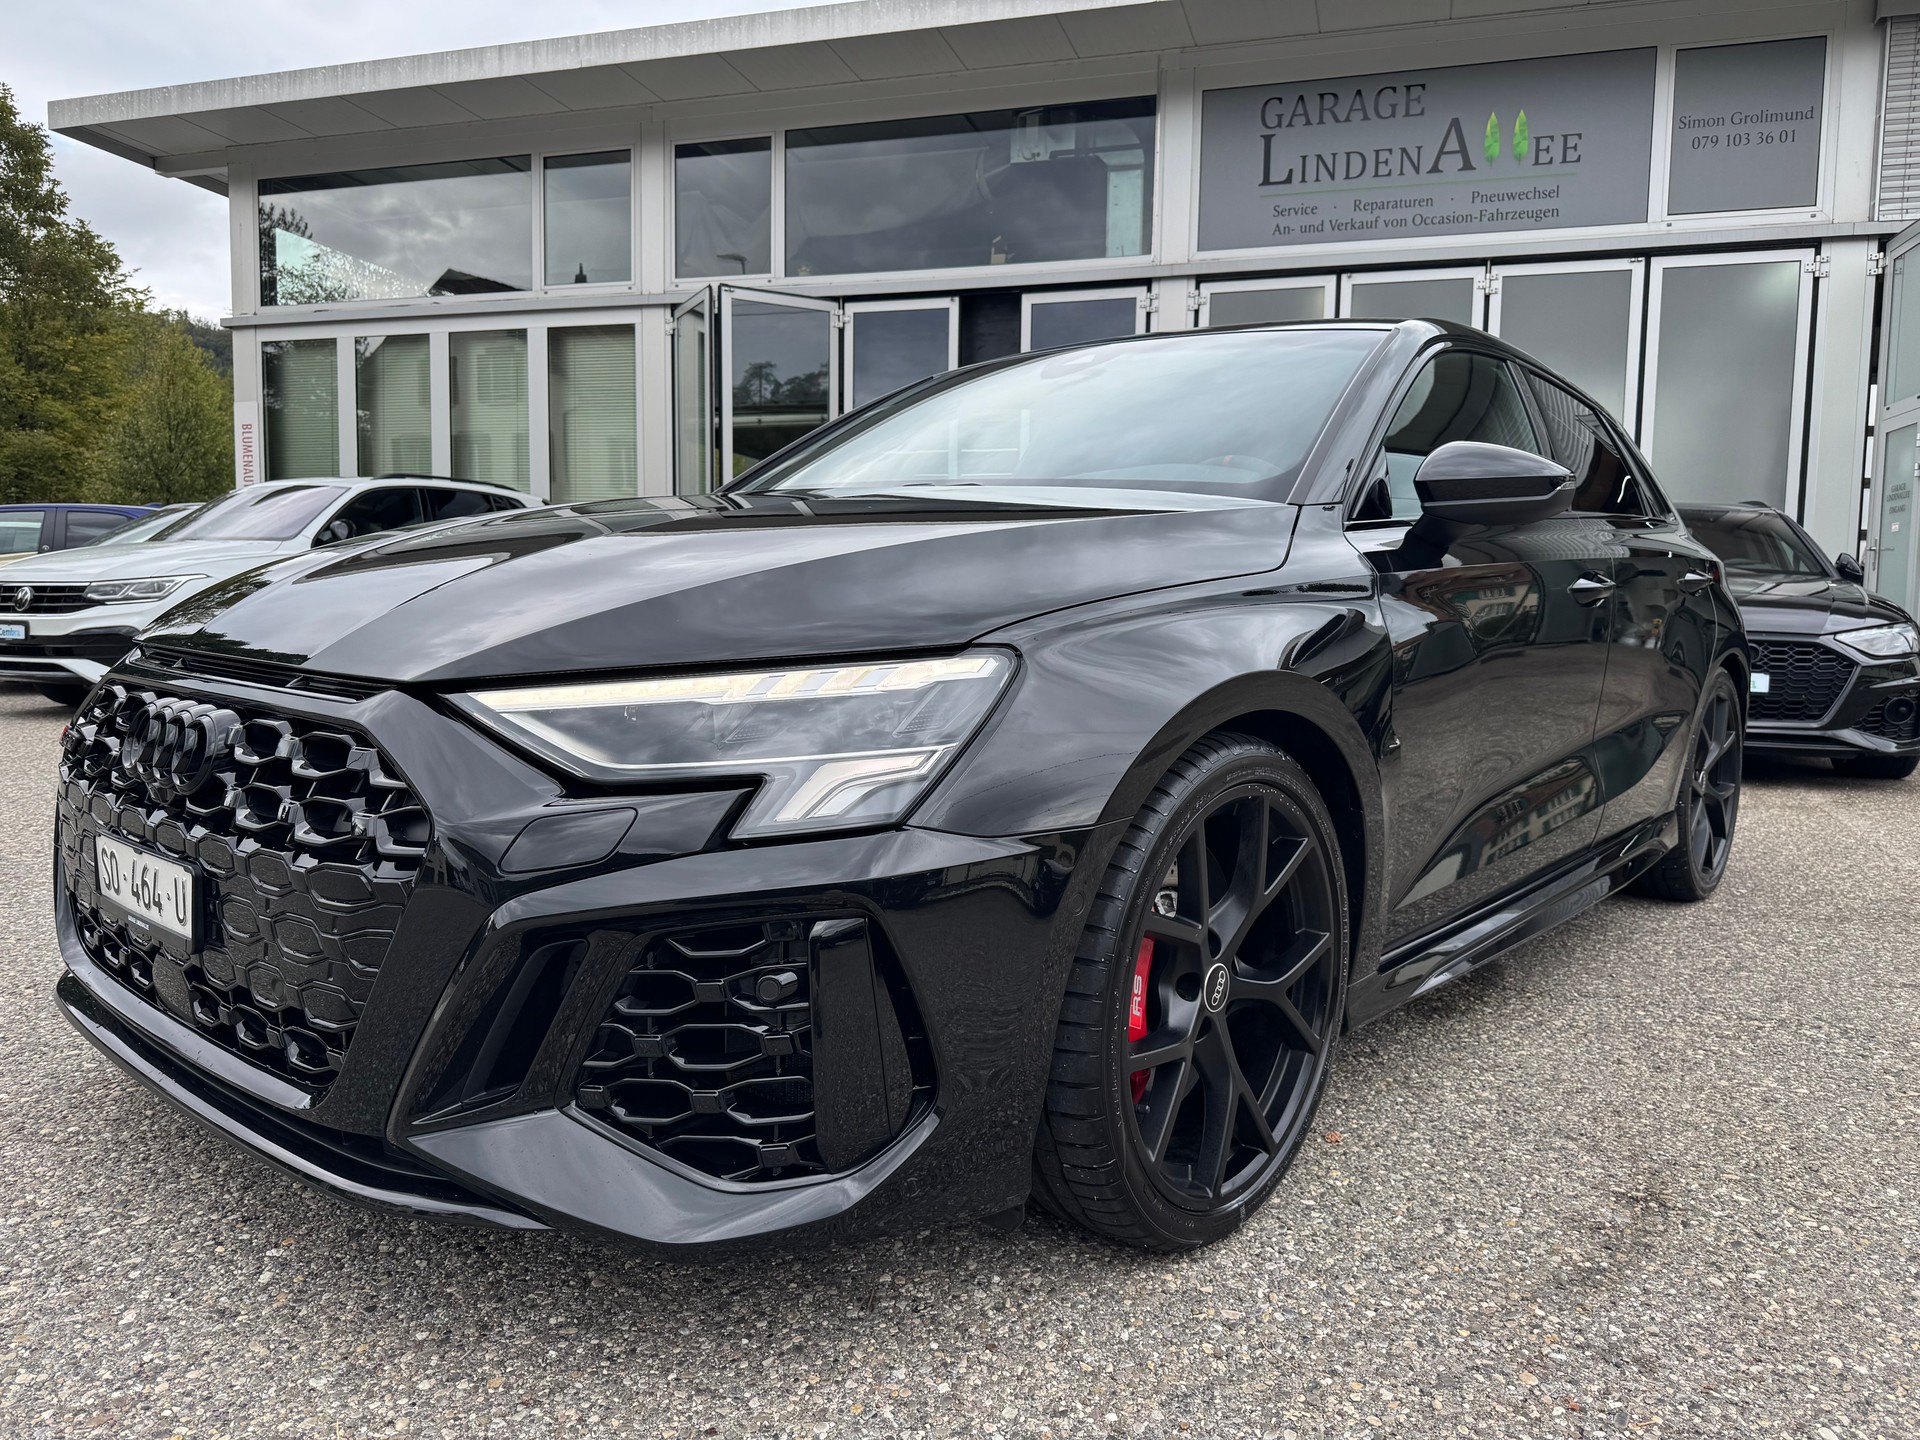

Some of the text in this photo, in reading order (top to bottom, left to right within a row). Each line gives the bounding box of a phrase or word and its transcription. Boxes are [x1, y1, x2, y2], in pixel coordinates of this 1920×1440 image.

[1260, 83, 1426, 129] GARAGE
[1678, 105, 1815, 130] Simon Grolimund
[1691, 129, 1797, 150] 079 103 36 01
[1272, 184, 1560, 218] Service Reparaturen Pneuwechsel
[1272, 206, 1560, 236] An- und Verkauf von Occasion-Fahrzeugen
[1132, 974, 1142, 1017] RS
